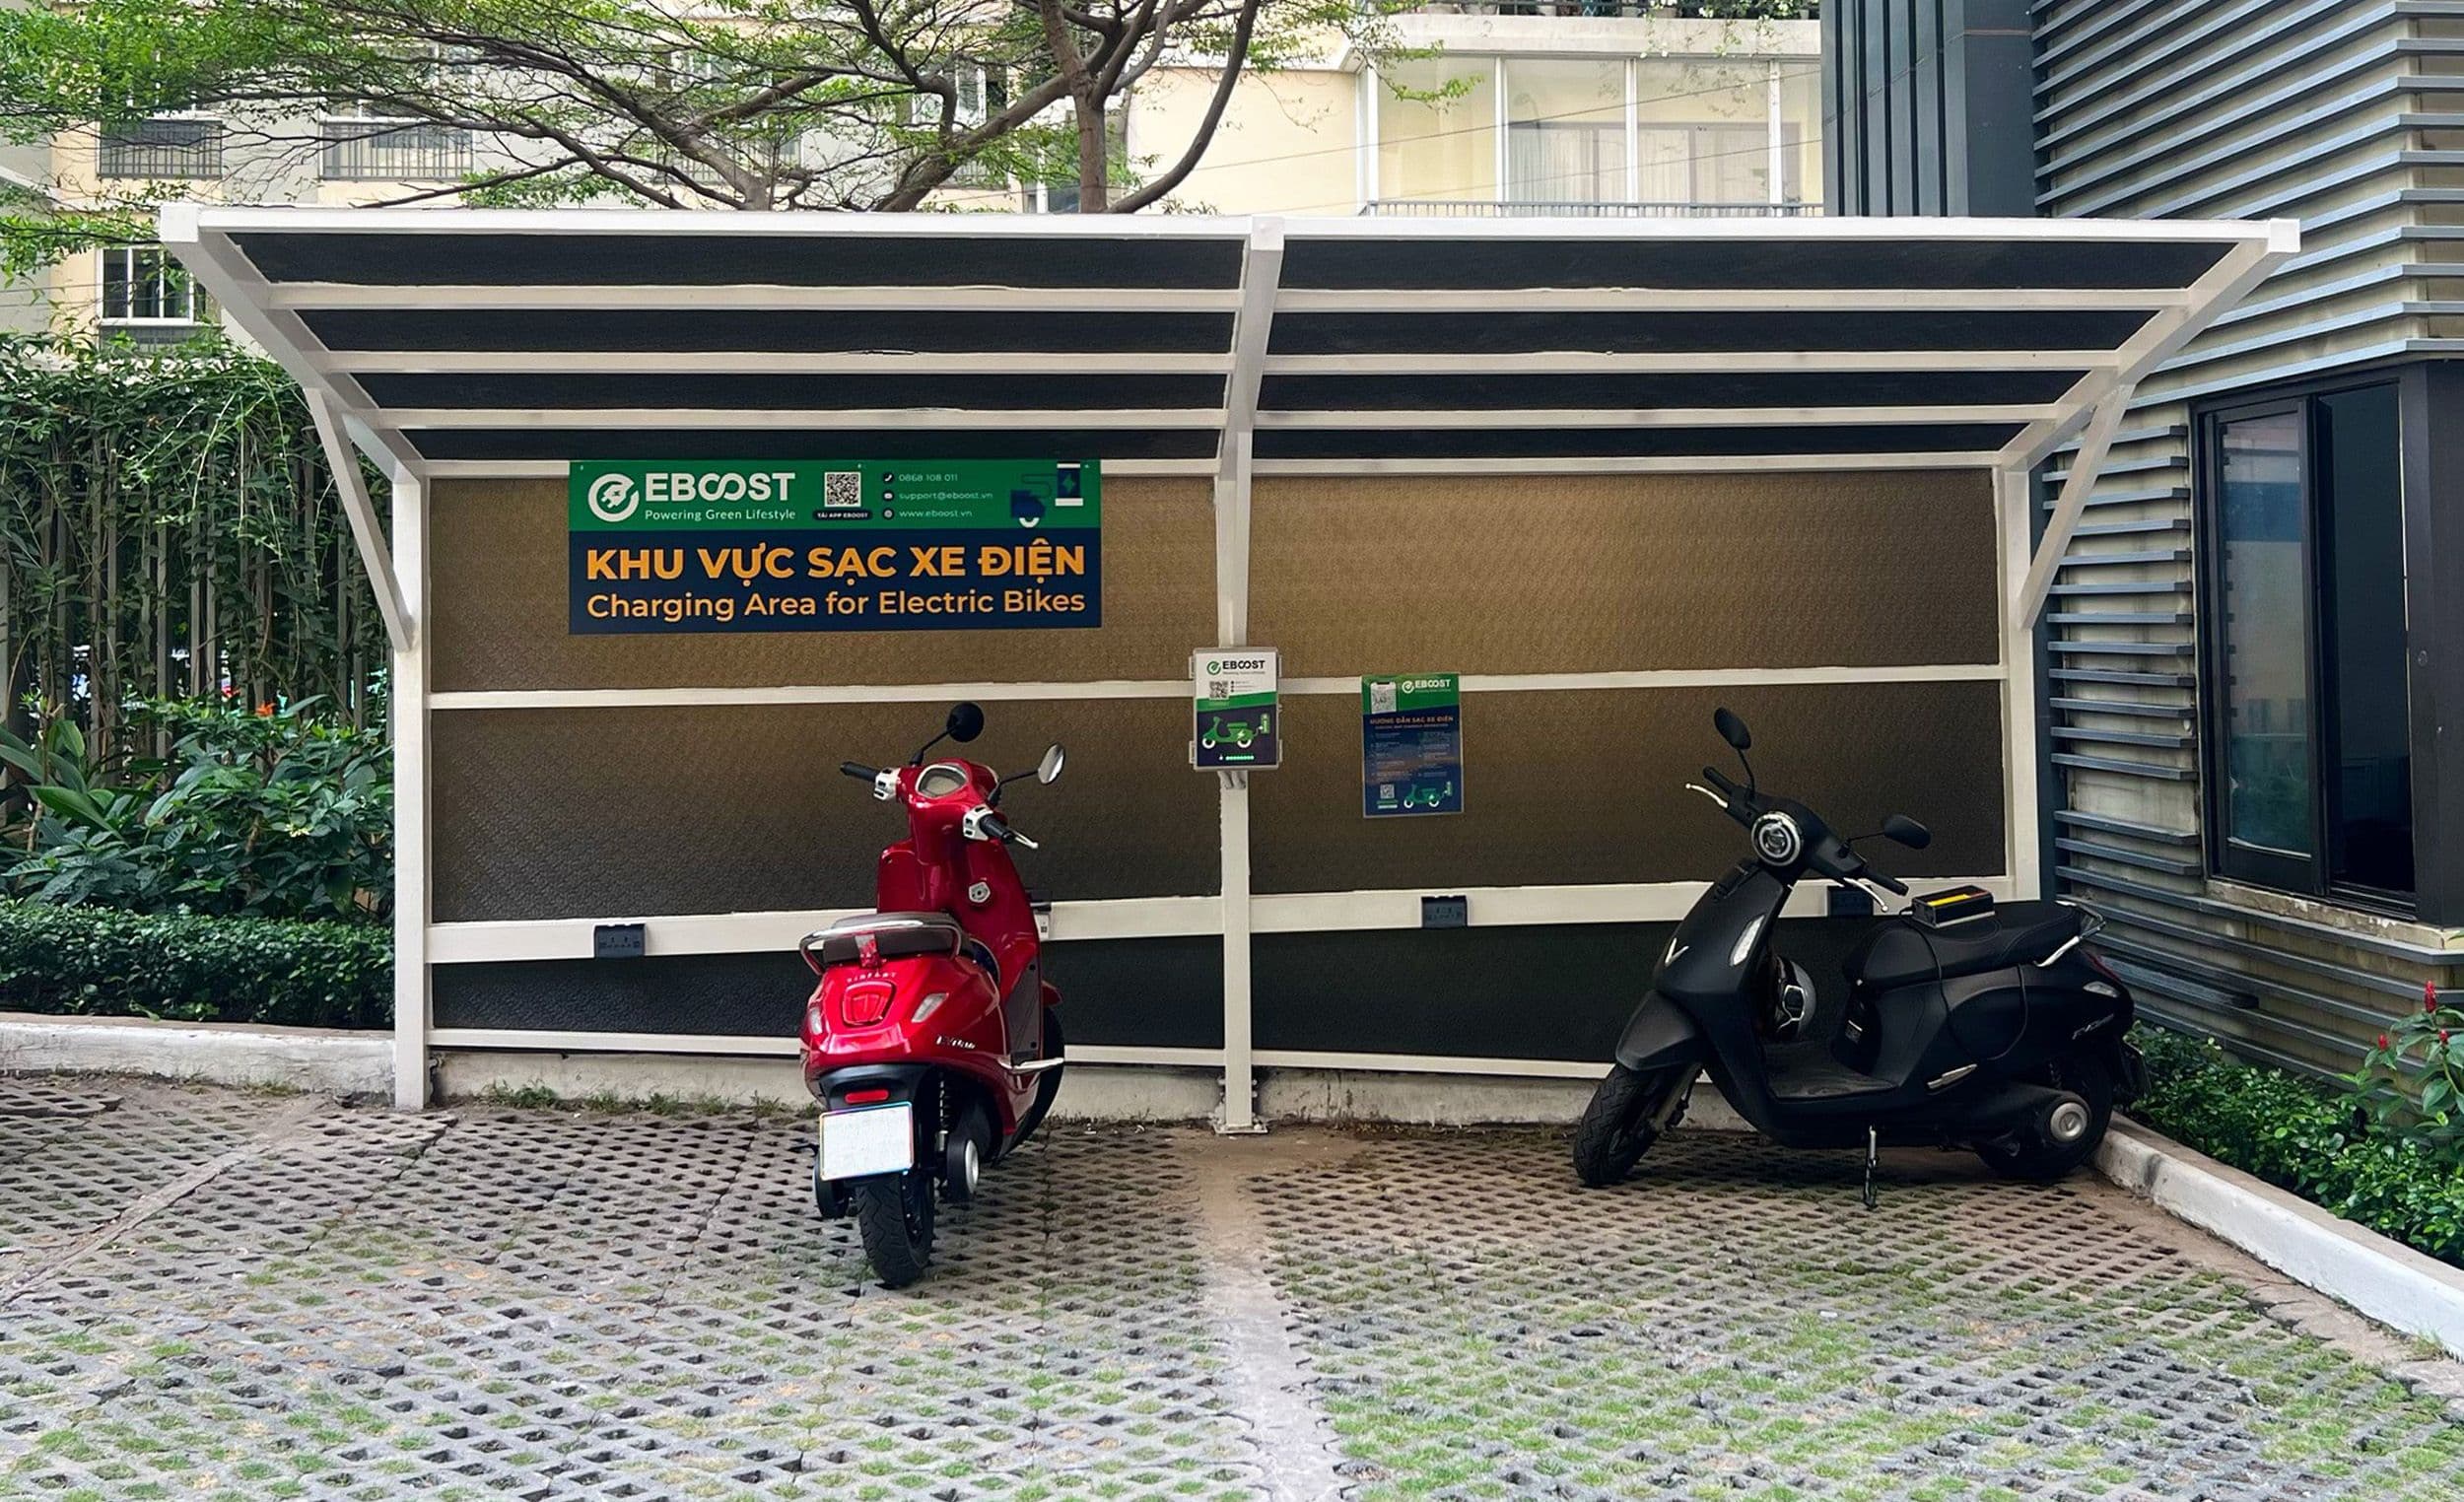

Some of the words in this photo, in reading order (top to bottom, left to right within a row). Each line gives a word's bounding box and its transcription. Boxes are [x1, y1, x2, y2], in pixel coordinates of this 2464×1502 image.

[646, 473, 795, 502] EBOOST
[645, 509, 702, 521] Powering
[706, 509, 742, 520] Green
[746, 508, 796, 520] Lifestyle
[587, 548, 684, 580] KHU
[697, 542, 794, 587] VỰC
[807, 547, 897, 586] SẠC
[909, 546, 966, 577] XE
[978, 538, 1084, 583] ĐIỆN
[586, 592, 734, 623] Charging
[744, 592, 816, 616] Area
[825, 590, 869, 615] for
[879, 589, 993, 614] Electric
[1004, 589, 1085, 613] Bikes
[1222, 660, 1266, 670] EBOOST
[1414, 679, 1452, 688] EBOOST
